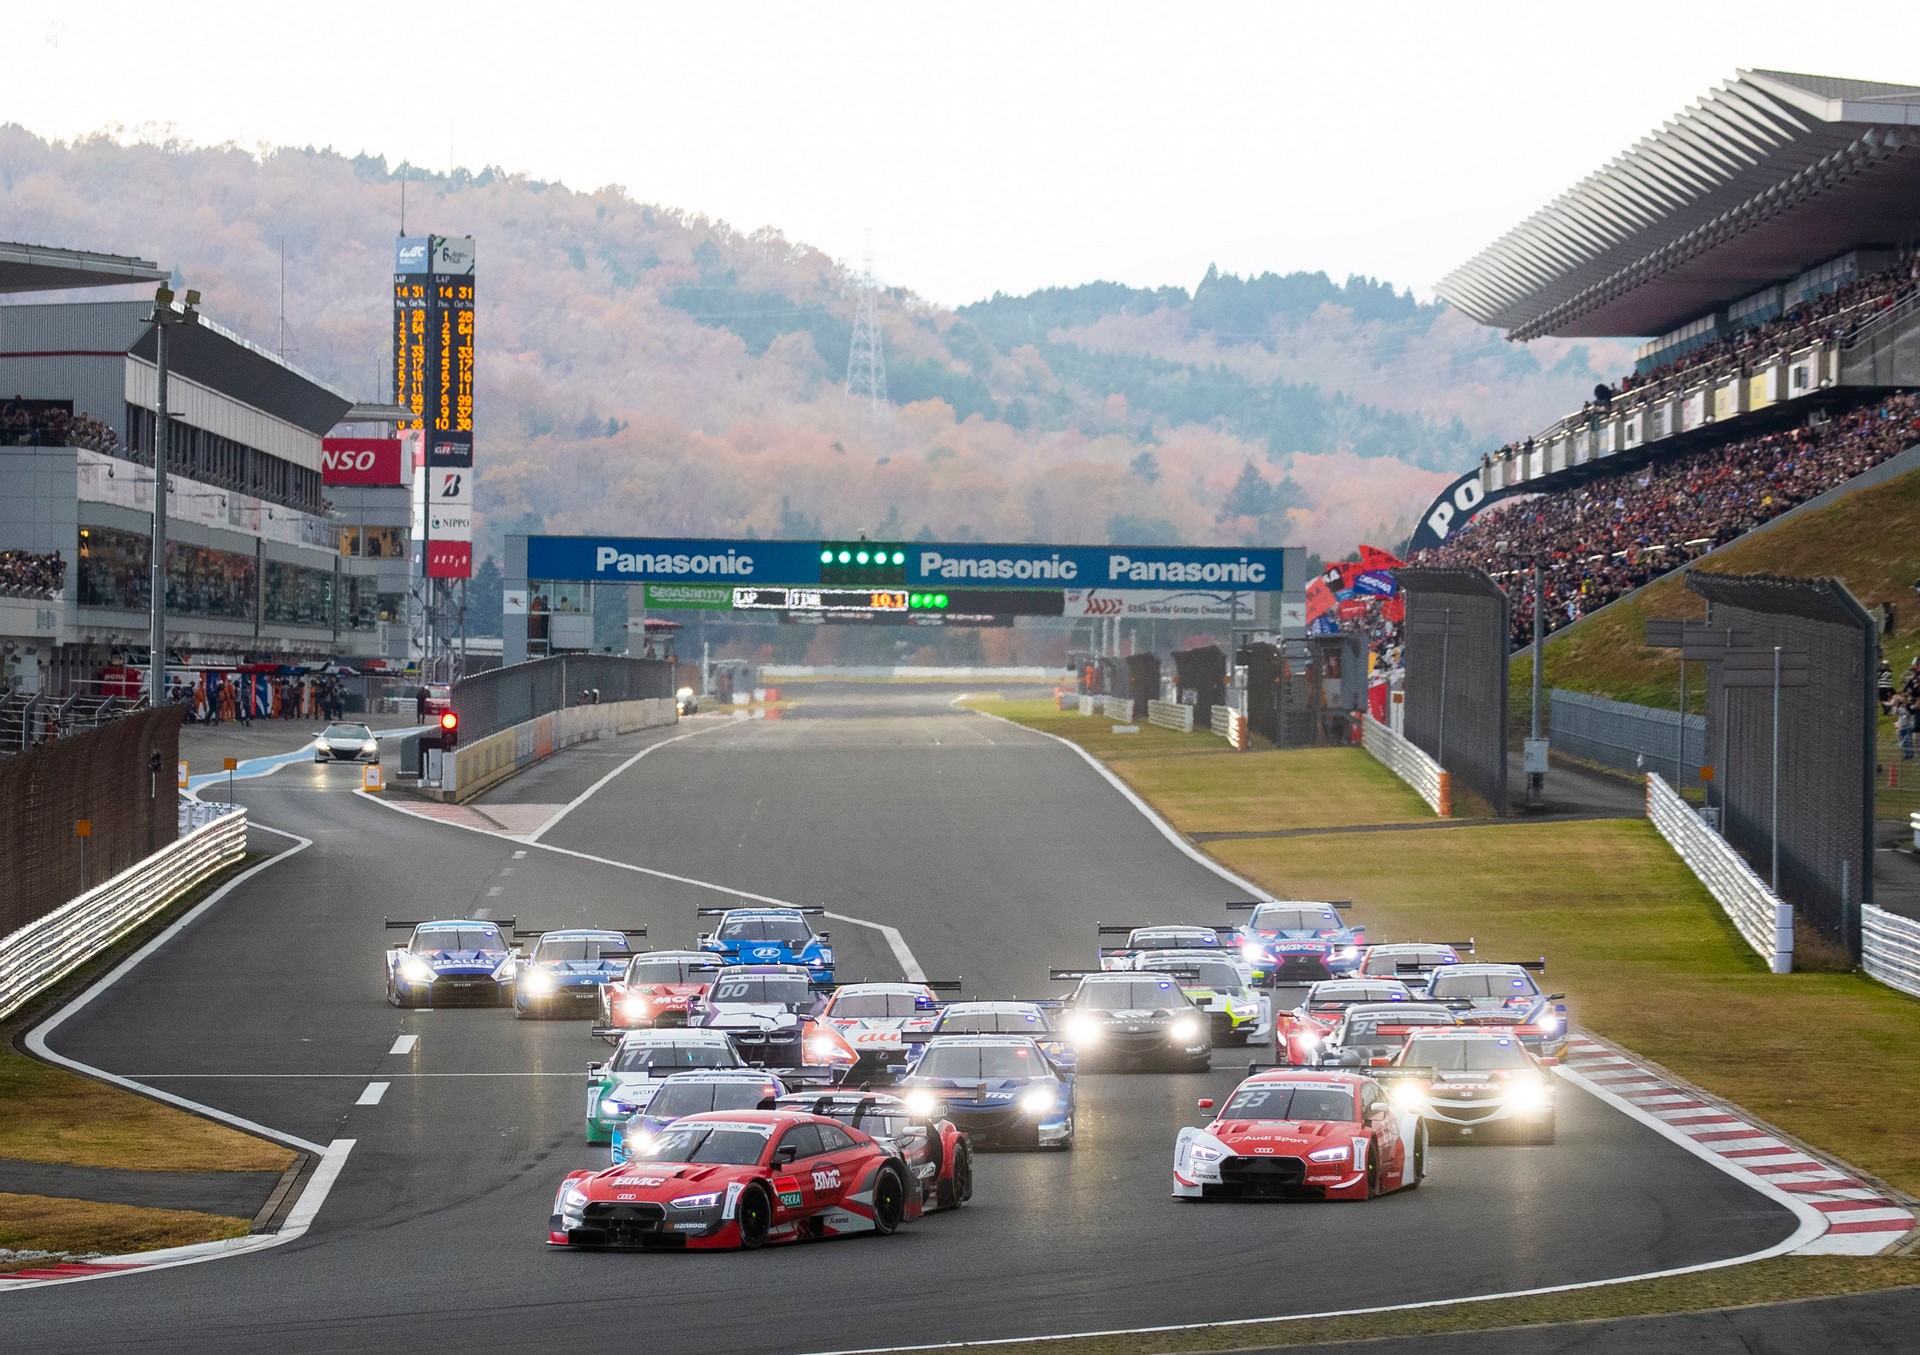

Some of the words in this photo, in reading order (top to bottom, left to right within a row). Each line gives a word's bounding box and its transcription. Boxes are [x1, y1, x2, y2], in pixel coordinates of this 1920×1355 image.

[436, 275, 450, 283] LAP
[397, 286, 409, 298] 14
[412, 285, 424, 298] 31
[439, 286, 453, 299] 14
[458, 286, 473, 300] 31
[400, 310, 406, 322] 1
[443, 310, 449, 322] 1
[458, 310, 474, 323] 28
[399, 322, 406, 334] 2
[441, 322, 450, 334] 2
[458, 323, 473, 335] 64
[399, 334, 407, 346] 3
[441, 334, 450, 346] 3
[466, 335, 471, 346] 1
[399, 346, 406, 357] 4
[441, 346, 450, 358] 4
[457, 346, 473, 359] 33
[398, 358, 406, 370] 5
[441, 358, 450, 370] 5
[459, 359, 473, 371] 17
[398, 369, 406, 381] 6
[441, 370, 450, 382] 6
[459, 370, 473, 382] 16
[398, 381, 405, 393] 7
[441, 382, 450, 394] 7
[459, 383, 471, 394] 11
[441, 394, 449, 406] 8
[457, 395, 473, 406] 99
[441, 406, 450, 418] 9
[457, 406, 473, 418] 37
[435, 417, 450, 430] 10
[457, 418, 473, 431] 38
[434, 446, 451, 455] GR
[442, 518, 470, 528] NIPPO
[596, 546, 754, 575] Panasonic
[920, 552, 1078, 580] Panasonic
[1109, 555, 1266, 583] Panasonic
[734, 590, 759, 604] LAP
[870, 592, 906, 608] 10.1
[724, 923, 744, 936] 4
[717, 983, 750, 999] 00
[857, 1032, 902, 1043] au
[622, 1048, 654, 1066] 11
[1229, 1091, 1271, 1109] 33
[1273, 1135, 1309, 1144] Sport
[612, 1176, 667, 1186] BMC
[811, 1169, 842, 1191] BMC
[781, 1193, 801, 1206] DEKRA
